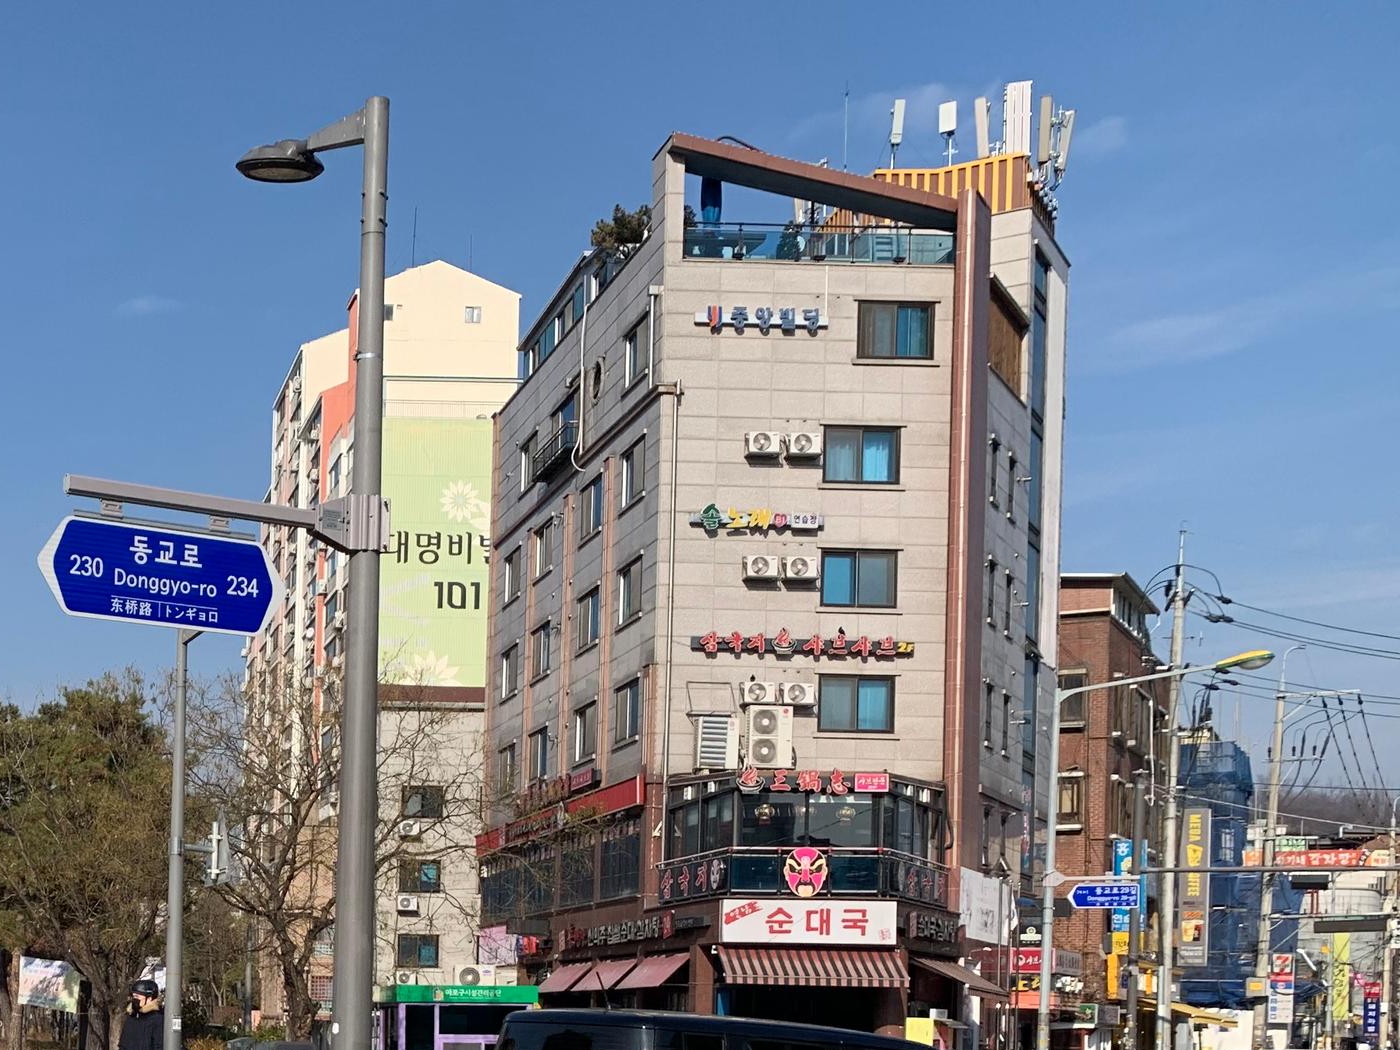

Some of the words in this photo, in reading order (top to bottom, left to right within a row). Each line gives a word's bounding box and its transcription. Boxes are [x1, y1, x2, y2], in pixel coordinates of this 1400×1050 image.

[731, 306, 820, 330] 중앙빌딩
[129, 536, 203, 568] 동교로
[69, 554, 104, 578] 230
[114, 568, 217, 597] Donggyo-ro
[226, 575, 260, 598] 234
[110, 598, 153, 617] 东桥路
[433, 582, 481, 610] 101
[165, 607, 219, 623] トンギョロ
[803, 634, 897, 656] 샤브샤브
[765, 907, 869, 936] 순대국
